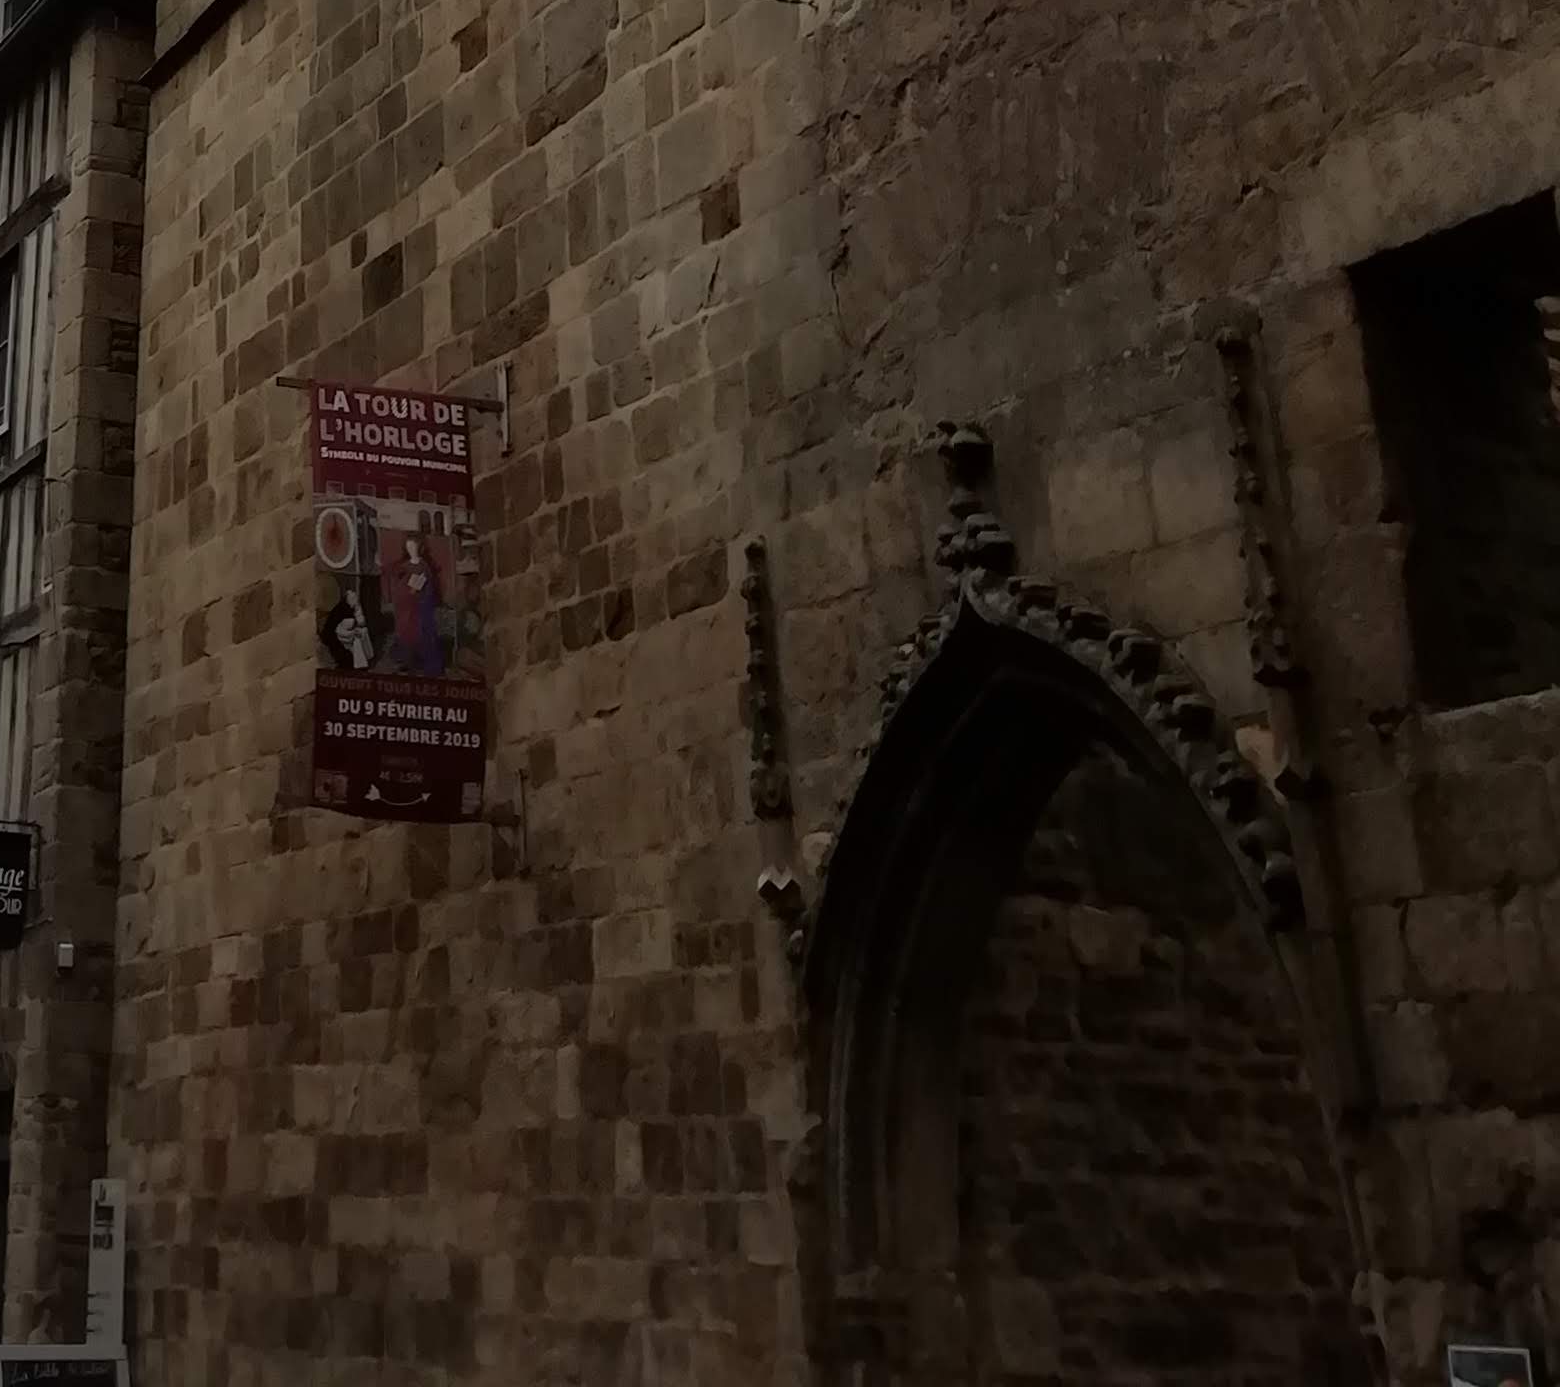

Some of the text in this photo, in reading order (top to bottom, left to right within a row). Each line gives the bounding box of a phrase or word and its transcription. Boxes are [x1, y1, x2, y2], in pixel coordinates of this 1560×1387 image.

[317, 387, 466, 427] LA TOUR DE
[319, 417, 468, 457] L'HORLOGE
[338, 698, 468, 724] DU 9 FÉVRIER AU
[323, 720, 481, 749] 30 SEPTEMBRE 2019
